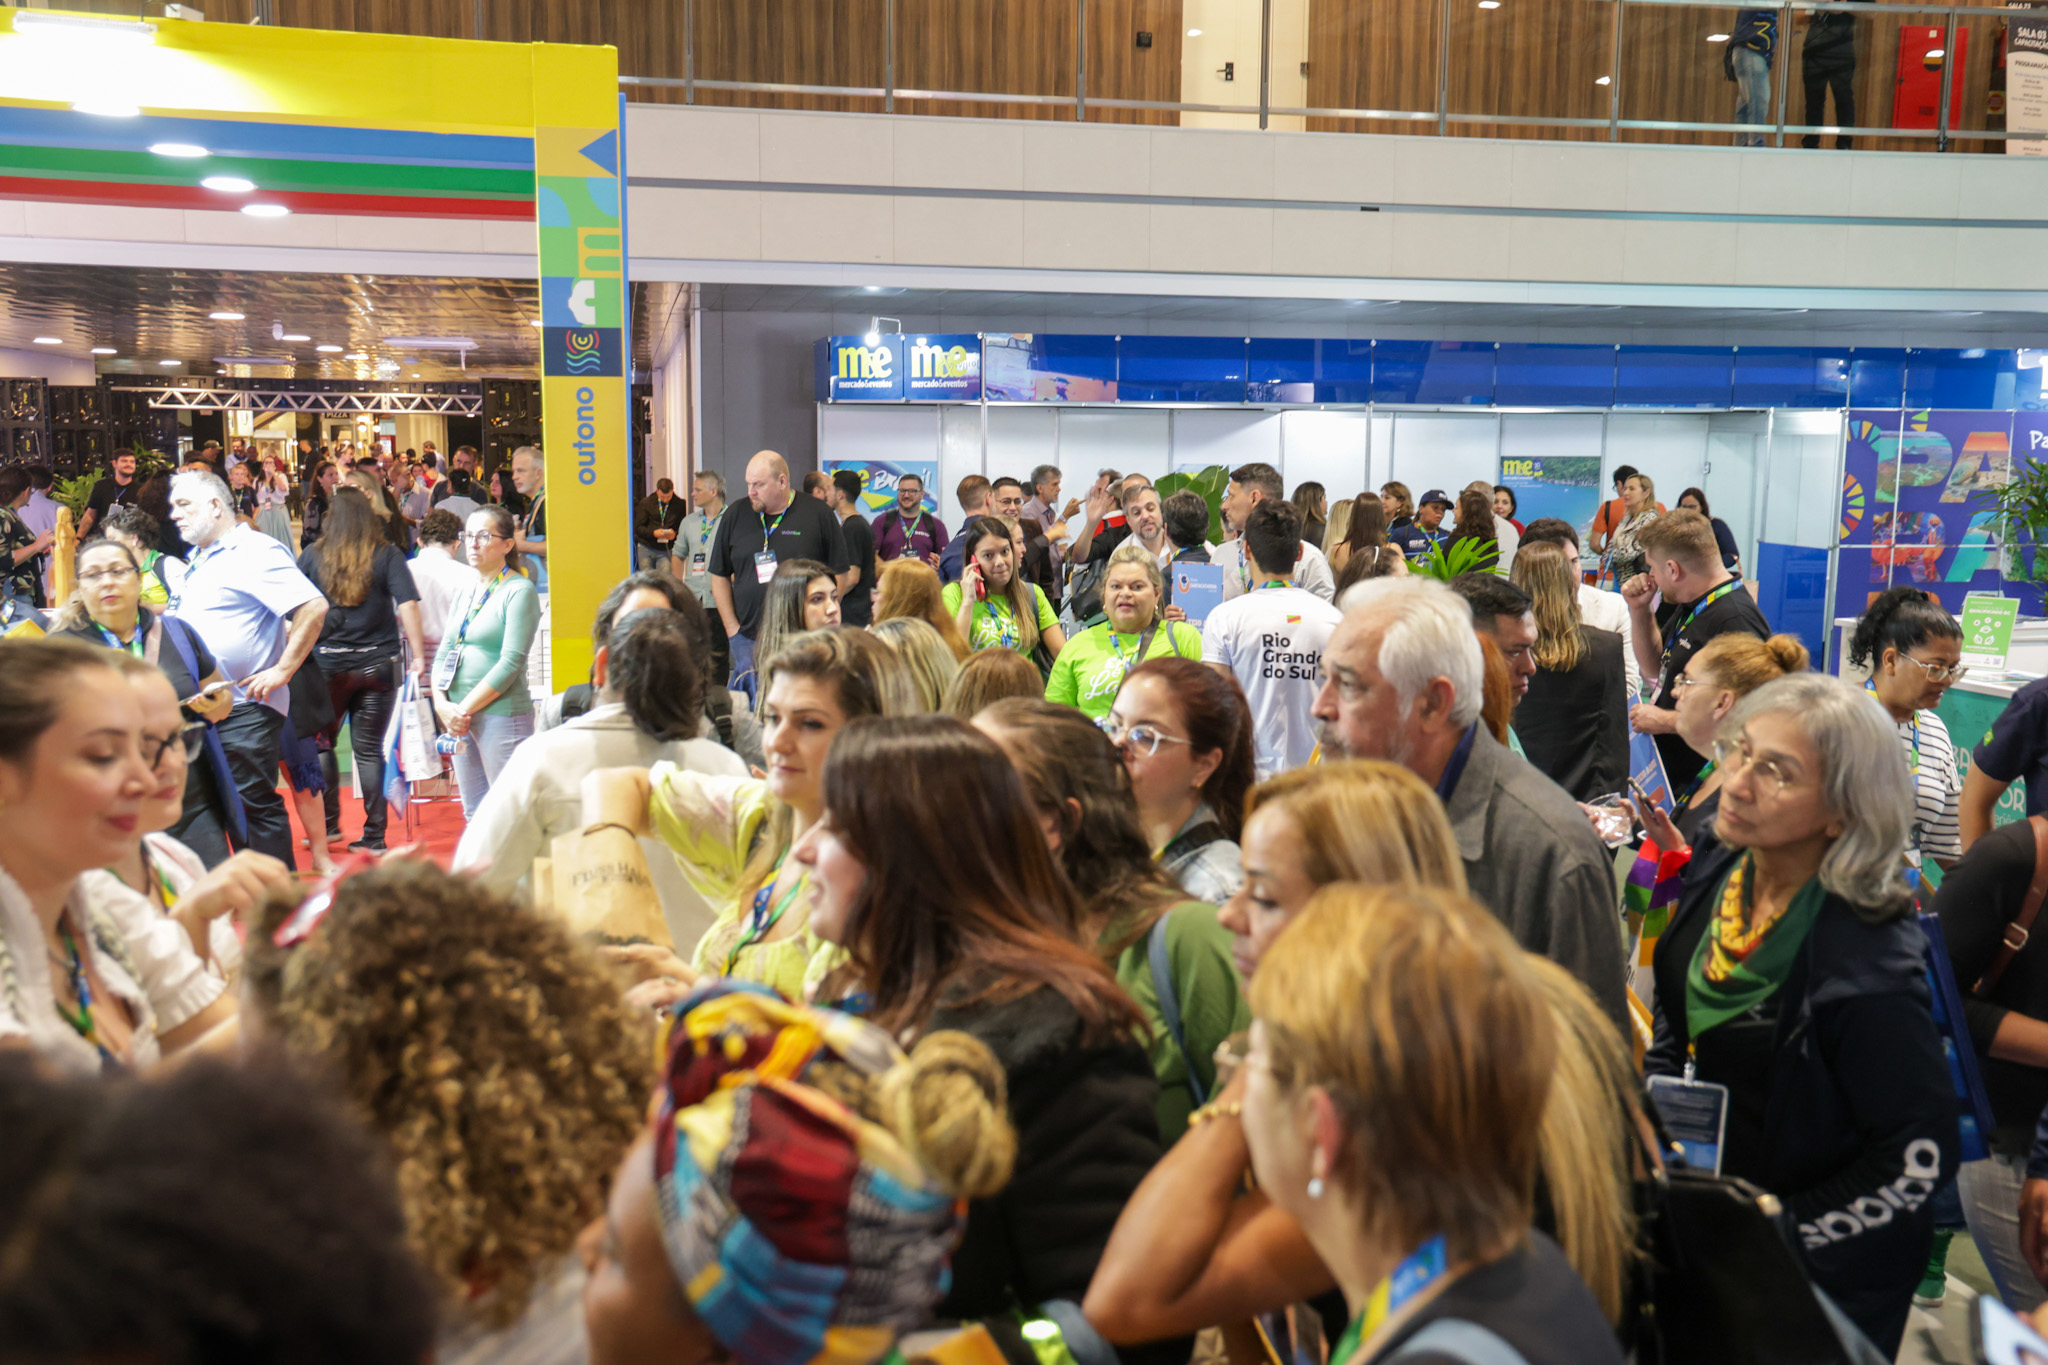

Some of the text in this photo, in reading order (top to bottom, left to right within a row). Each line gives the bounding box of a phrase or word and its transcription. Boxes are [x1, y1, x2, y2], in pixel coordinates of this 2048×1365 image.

[2017, 26, 2047, 40] SALA 03
[838, 346, 893, 379] m&e
[910, 344, 967, 379] m&e
[838, 379, 893, 389] mercado&eventos
[911, 379, 968, 389] mercado&eventos
[572, 386, 597, 486] outono
[1503, 459, 1533, 476] m&e
[873, 468, 931, 490] Brail
[1262, 632, 1290, 648] Rio
[1263, 665, 1316, 680] do Sul
